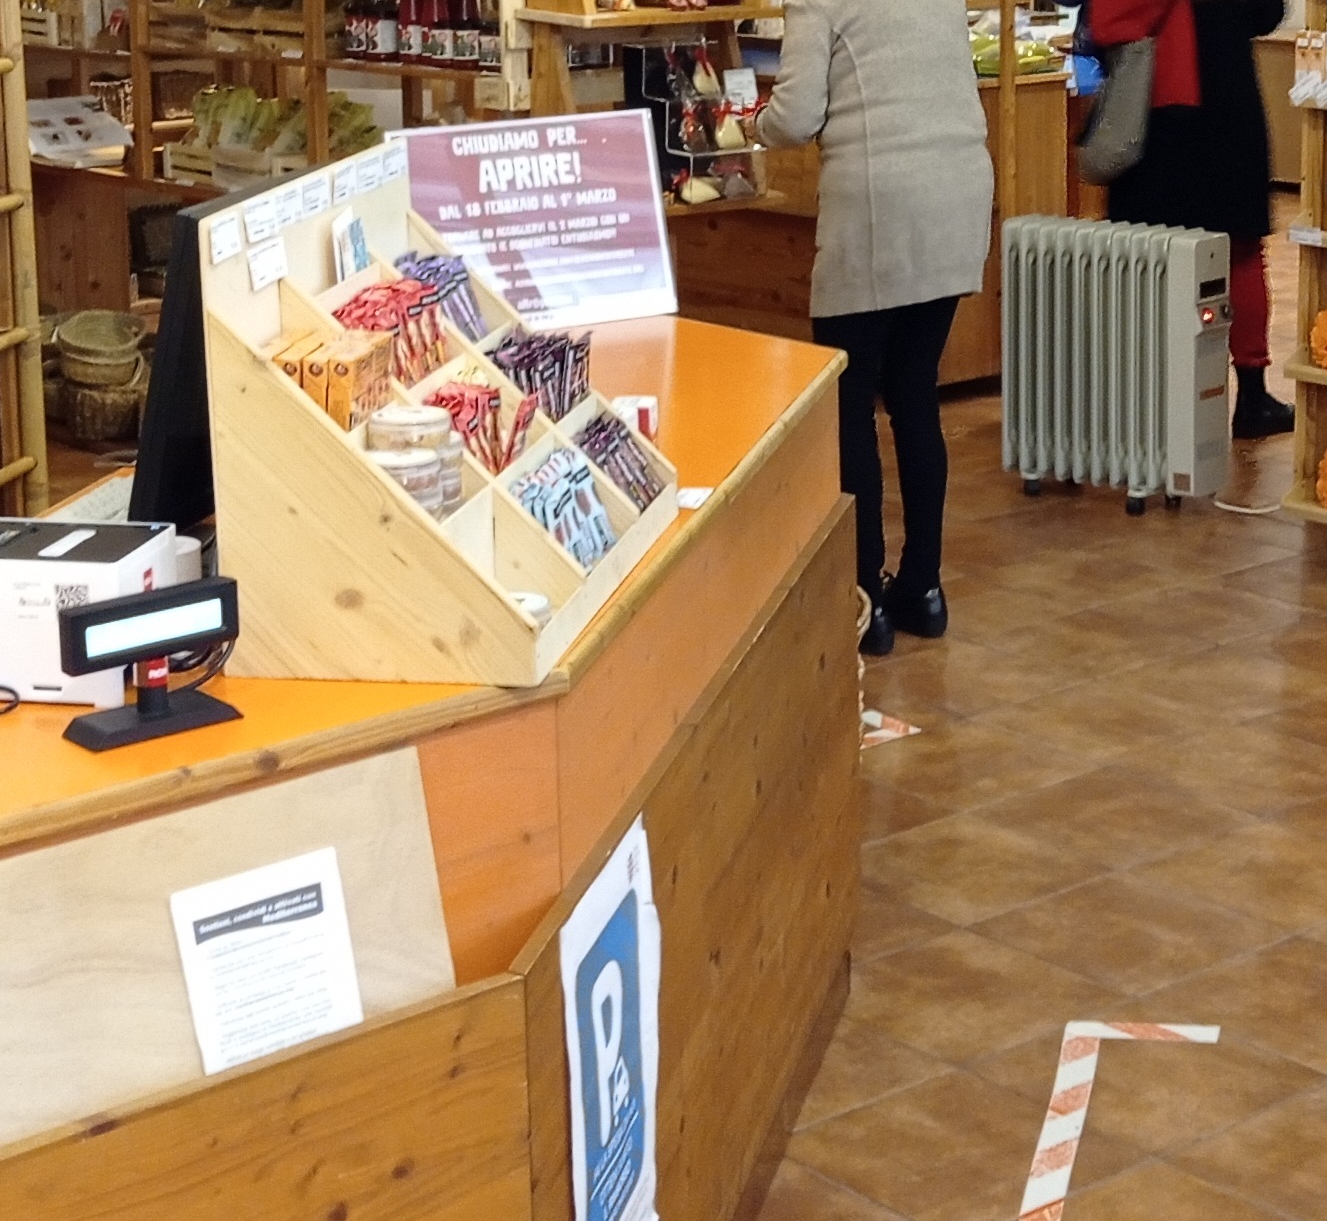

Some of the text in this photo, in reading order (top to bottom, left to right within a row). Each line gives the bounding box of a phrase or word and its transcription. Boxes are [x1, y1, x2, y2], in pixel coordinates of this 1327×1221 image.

[452, 125, 588, 156] CHIUDIAMO PER...
[479, 151, 582, 193] APRIRE!
[438, 205, 461, 220] DAL
[484, 196, 540, 216] FEBBRAIO
[542, 194, 558, 209] AL
[576, 187, 617, 205] MARZO
